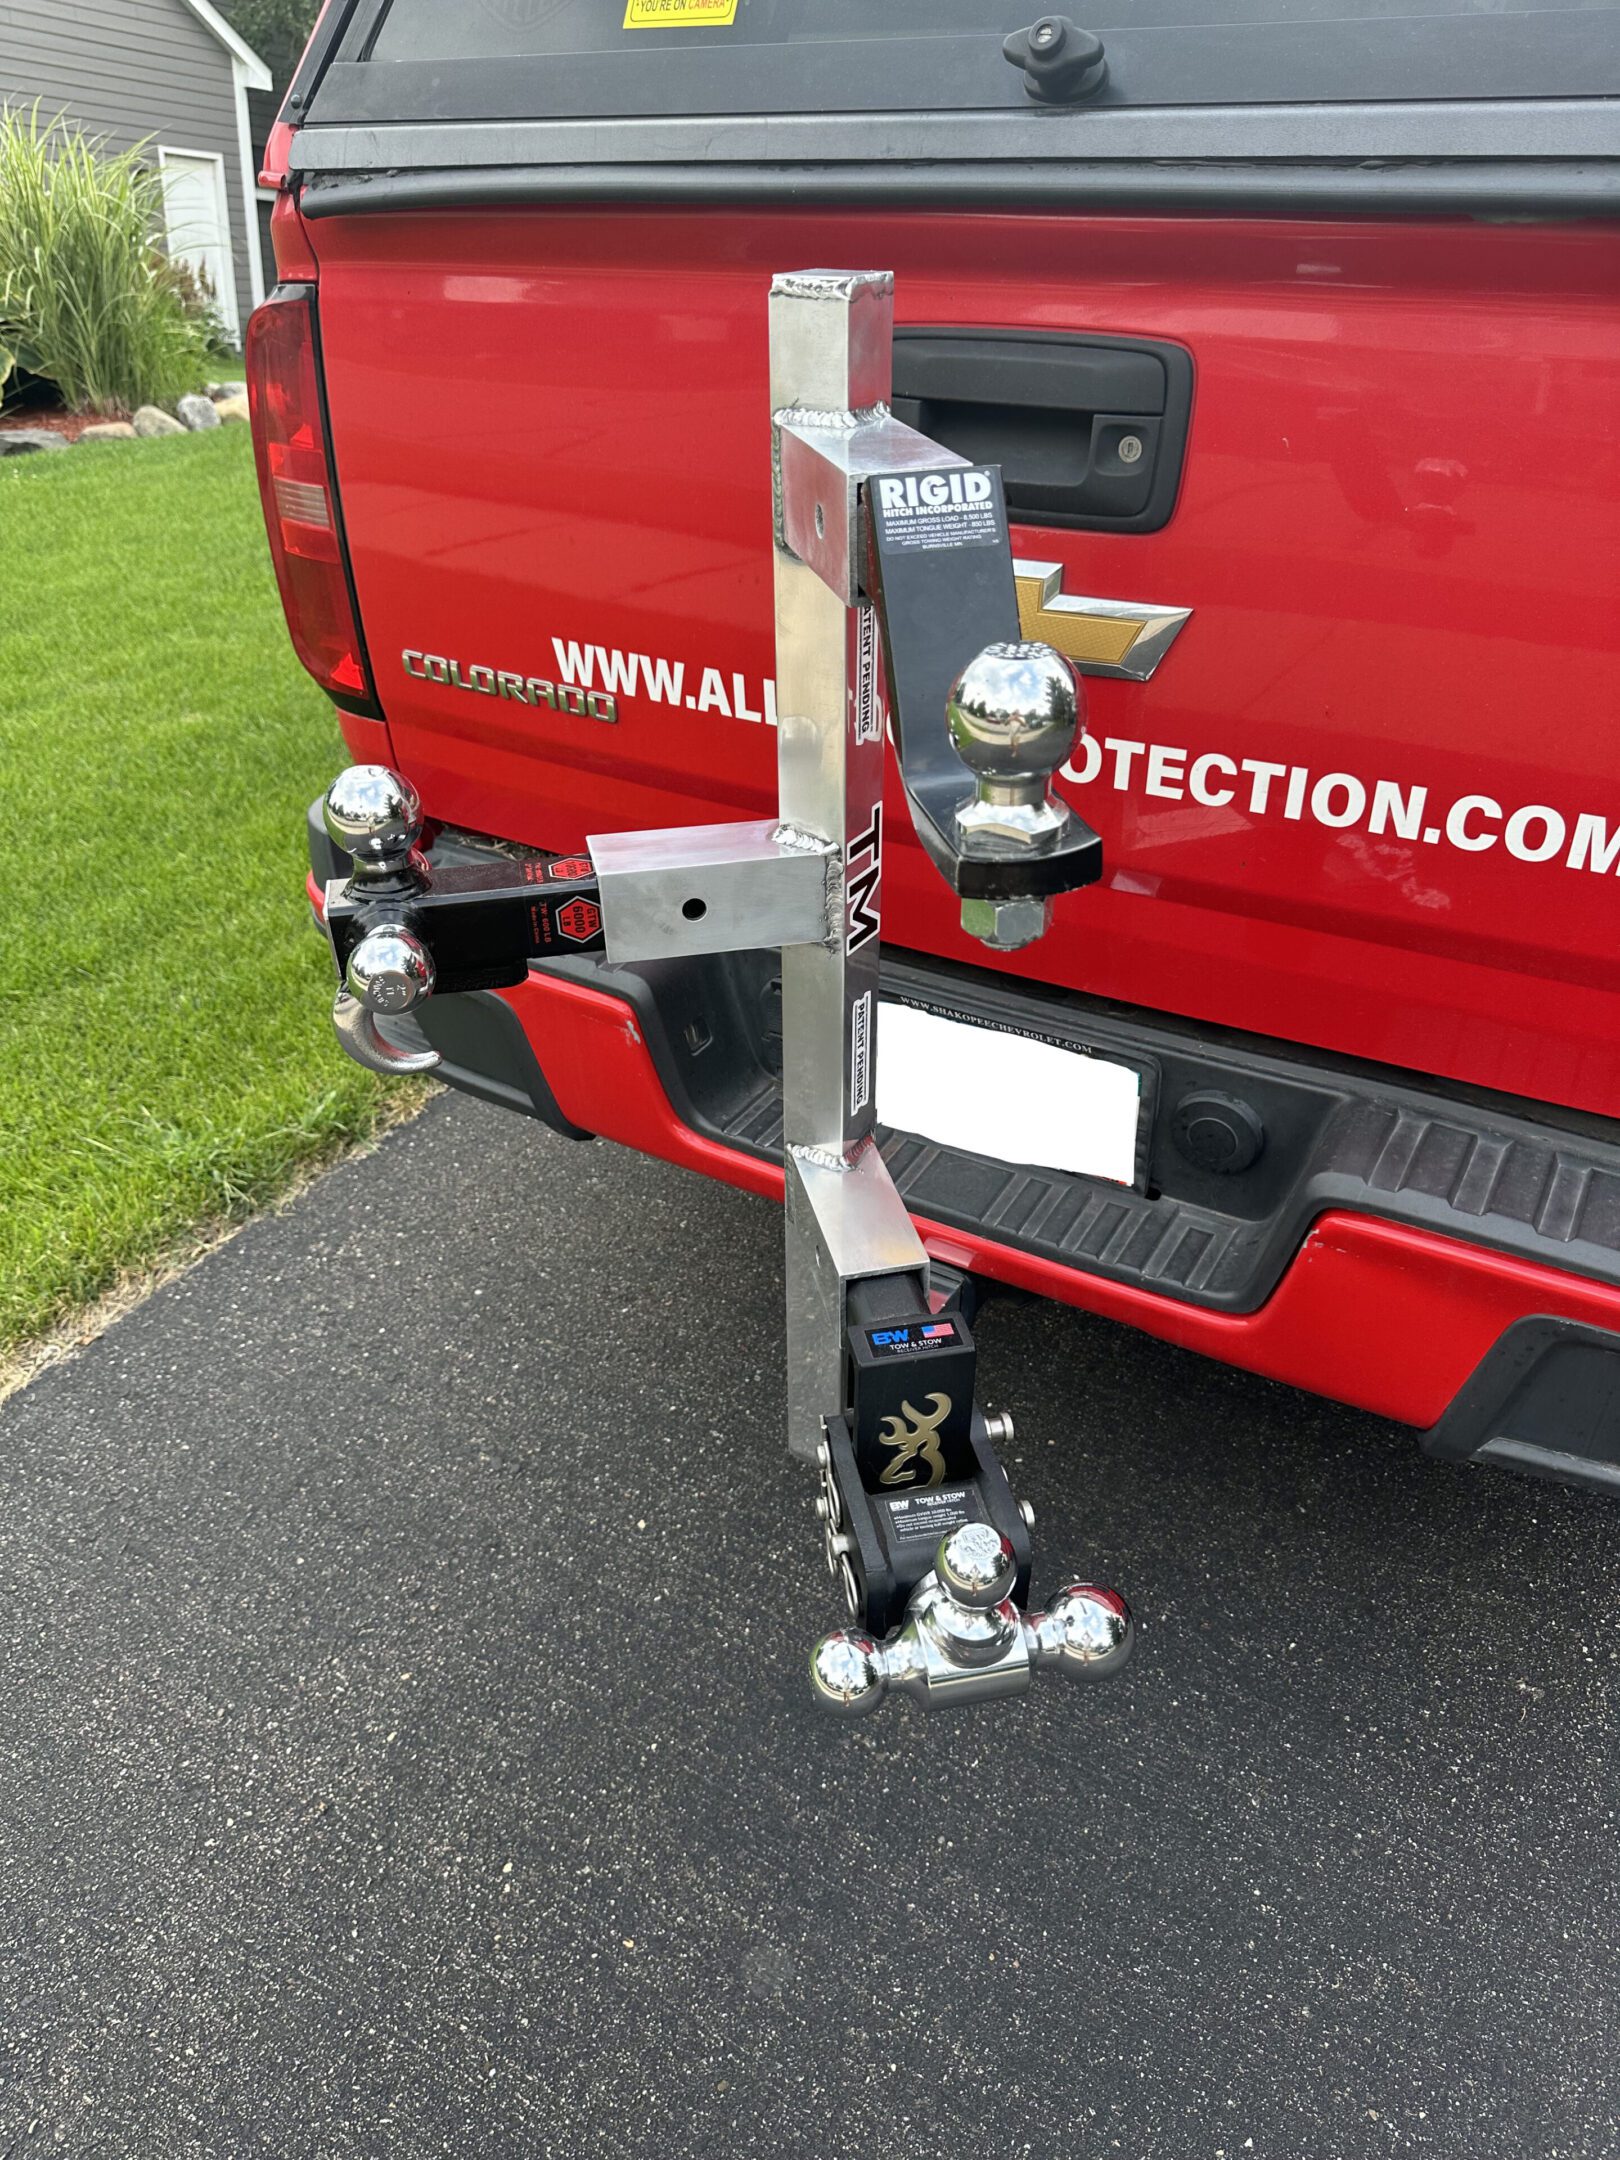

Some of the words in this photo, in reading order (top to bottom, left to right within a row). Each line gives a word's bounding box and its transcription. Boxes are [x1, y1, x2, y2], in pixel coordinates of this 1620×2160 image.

[673, 0, 687, 10] ON
[688, 0, 725, 9] CAMERA
[879, 472, 992, 509] RIGID
[883, 507, 914, 518] HITCH
[915, 501, 993, 515] INCORPORATED
[886, 519, 917, 527] MAXIMUM
[917, 517, 941, 525] GROSS
[941, 515, 959, 523] LOAD
[885, 526, 916, 535] MAXIMUM
[916, 524, 942, 532] TONGUE
[942, 521, 967, 530] WEIGHT
[862, 605, 872, 657] ATENT
[401, 648, 618, 725] COLORADO
[861, 662, 872, 734] PENDING
[563, 916, 572, 927] LB
[573, 905, 586, 933] 6000
[587, 907, 598, 928] GTW
[857, 1002, 865, 1049] PATENT
[900, 996, 1092, 1054] WWW.SHAKOPEECHEVROLET.COM
[856, 1050, 864, 1105] PENDING
[890, 1342, 910, 1350] TOW
[918, 1338, 942, 1346] STOW
[914, 1496, 934, 1504] TOW
[942, 1491, 965, 1500] STOW
